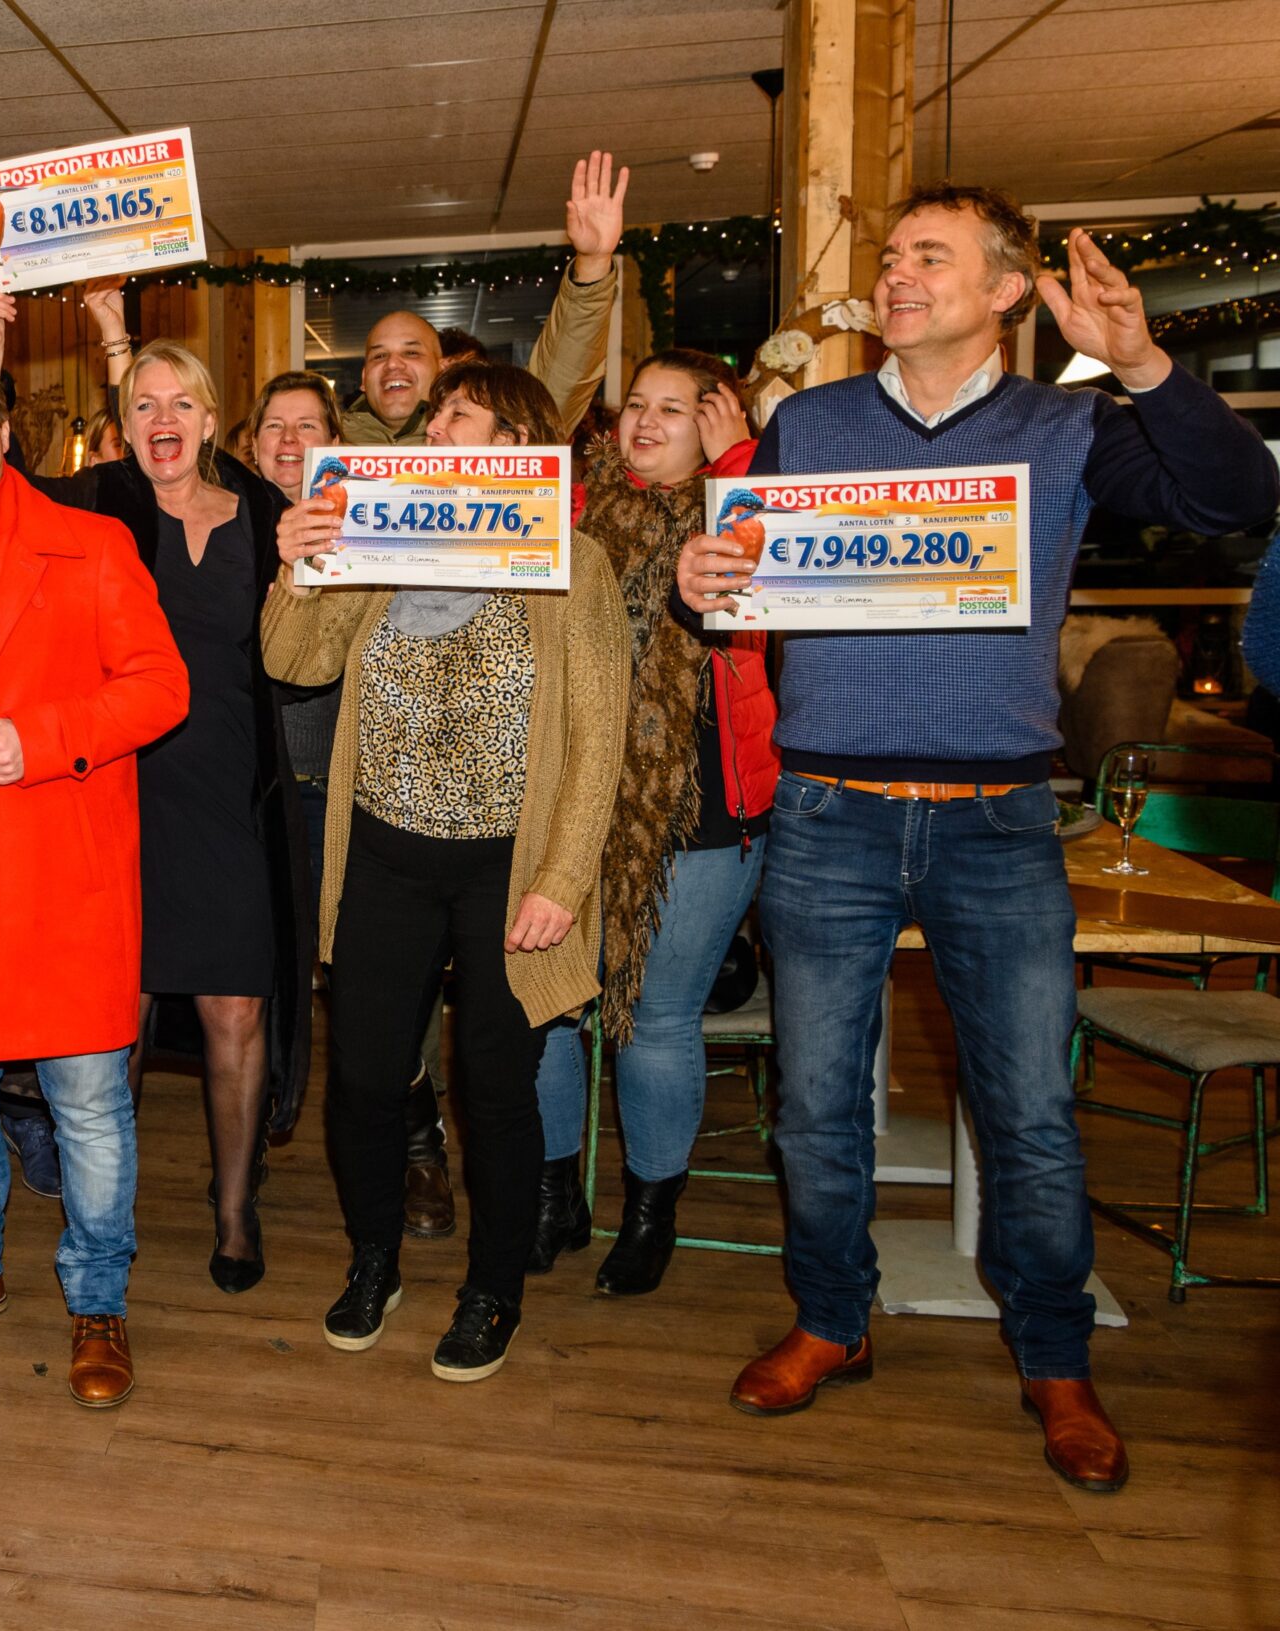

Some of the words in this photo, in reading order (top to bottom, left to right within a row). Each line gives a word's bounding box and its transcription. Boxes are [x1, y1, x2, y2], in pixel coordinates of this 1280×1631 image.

[0, 156, 93, 188] POSTCODE
[96, 142, 170, 169] KANJER
[57, 186, 79, 196] AANTAL
[80, 183, 99, 192] LOTEN
[119, 172, 164, 185] KANJERPUNTEN
[167, 168, 182, 177] 420
[153, 241, 189, 252] POSTCODE
[158, 248, 186, 256] LOTERIJ
[350, 458, 455, 476] POSTCODE
[460, 458, 543, 476] KANJER
[766, 485, 890, 508] POSTCODE
[897, 479, 996, 503] KANJER
[905, 517, 911, 525] 3
[923, 515, 985, 524] KANJERPUNTEN
[959, 602, 1007, 610] POSTCODE
